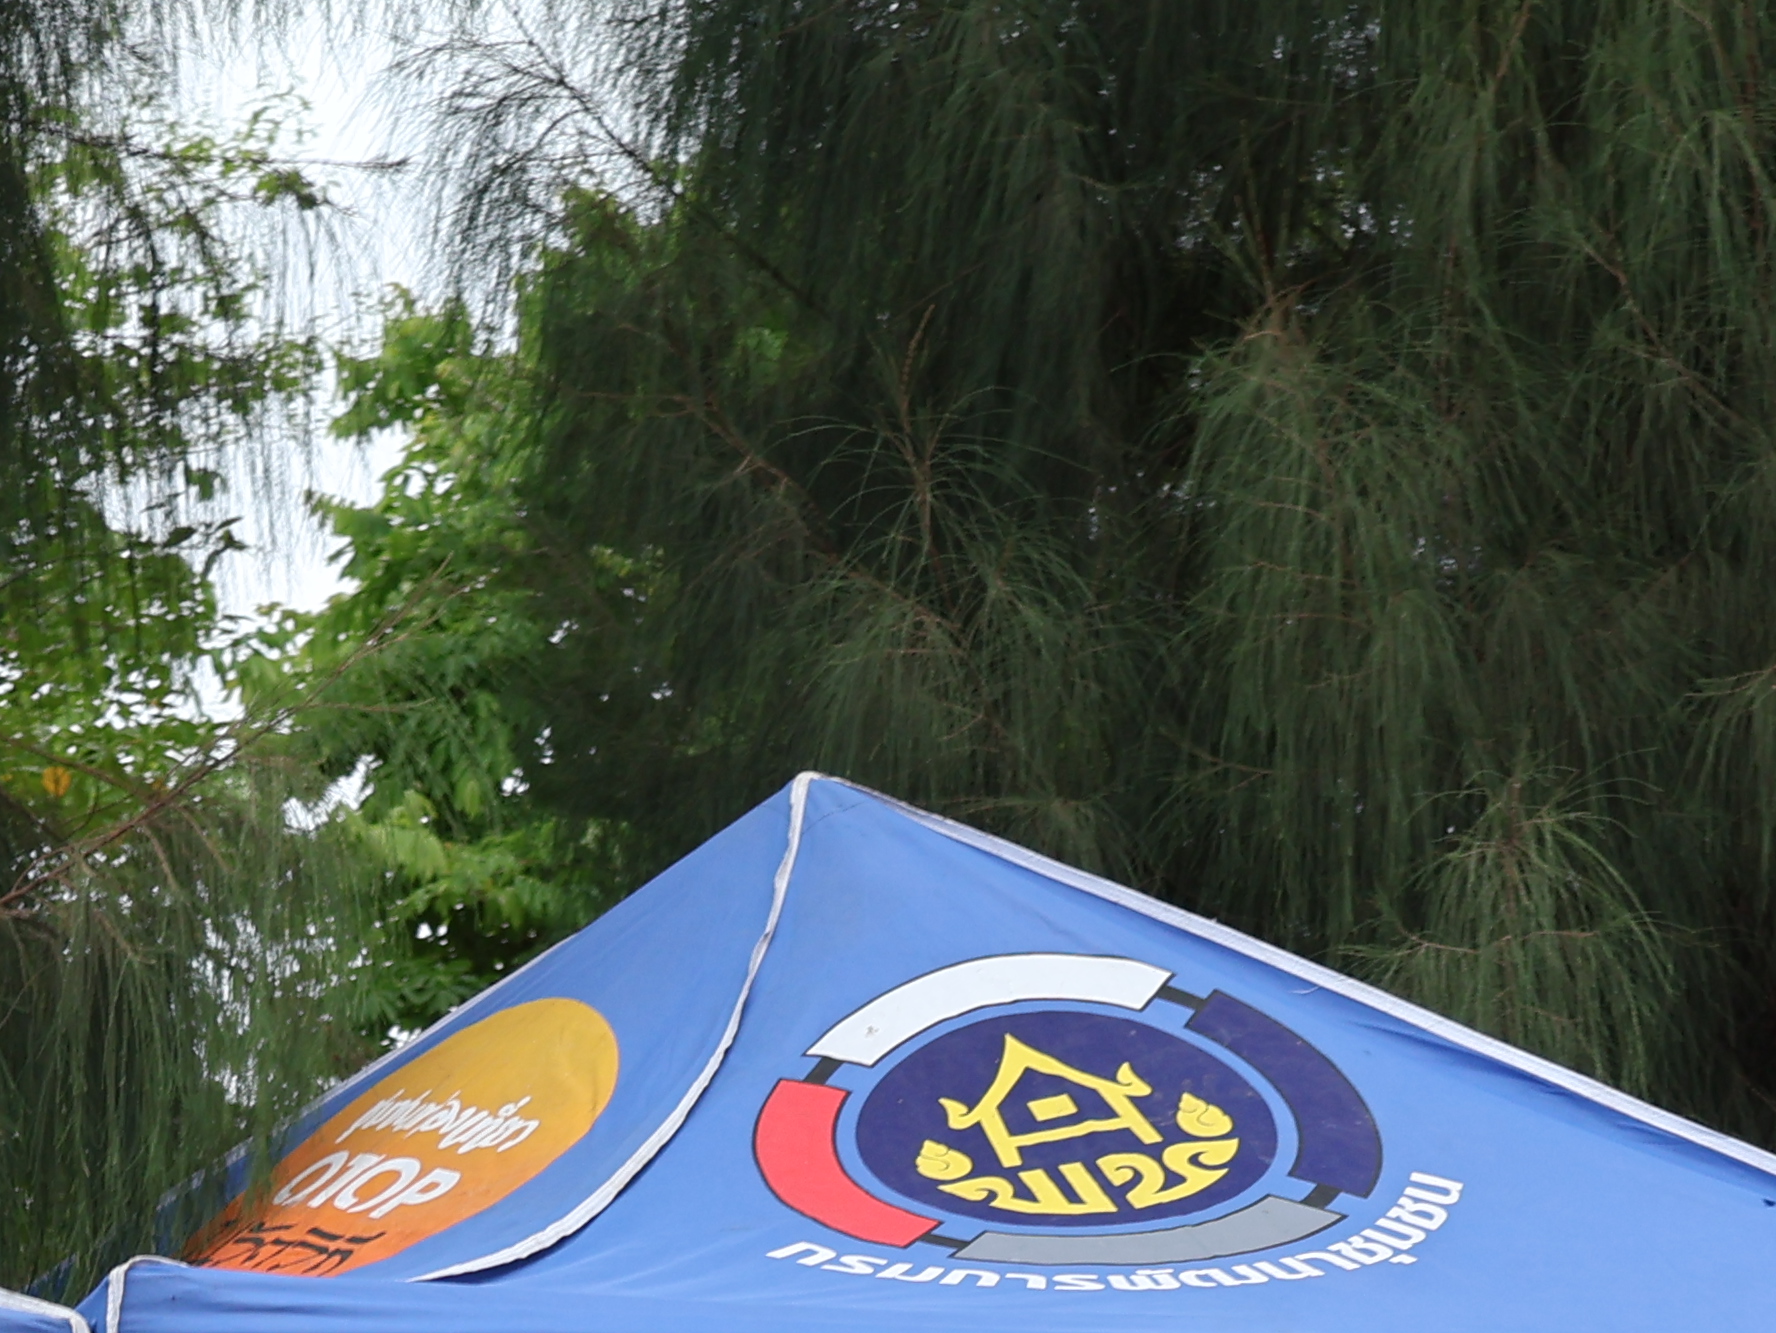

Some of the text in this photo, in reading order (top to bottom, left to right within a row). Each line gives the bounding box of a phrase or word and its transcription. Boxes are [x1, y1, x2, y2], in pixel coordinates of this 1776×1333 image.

[273, 1149, 462, 1220] OTOP
[765, 1171, 1464, 1291] กรมการพัฒนาชุมชน
